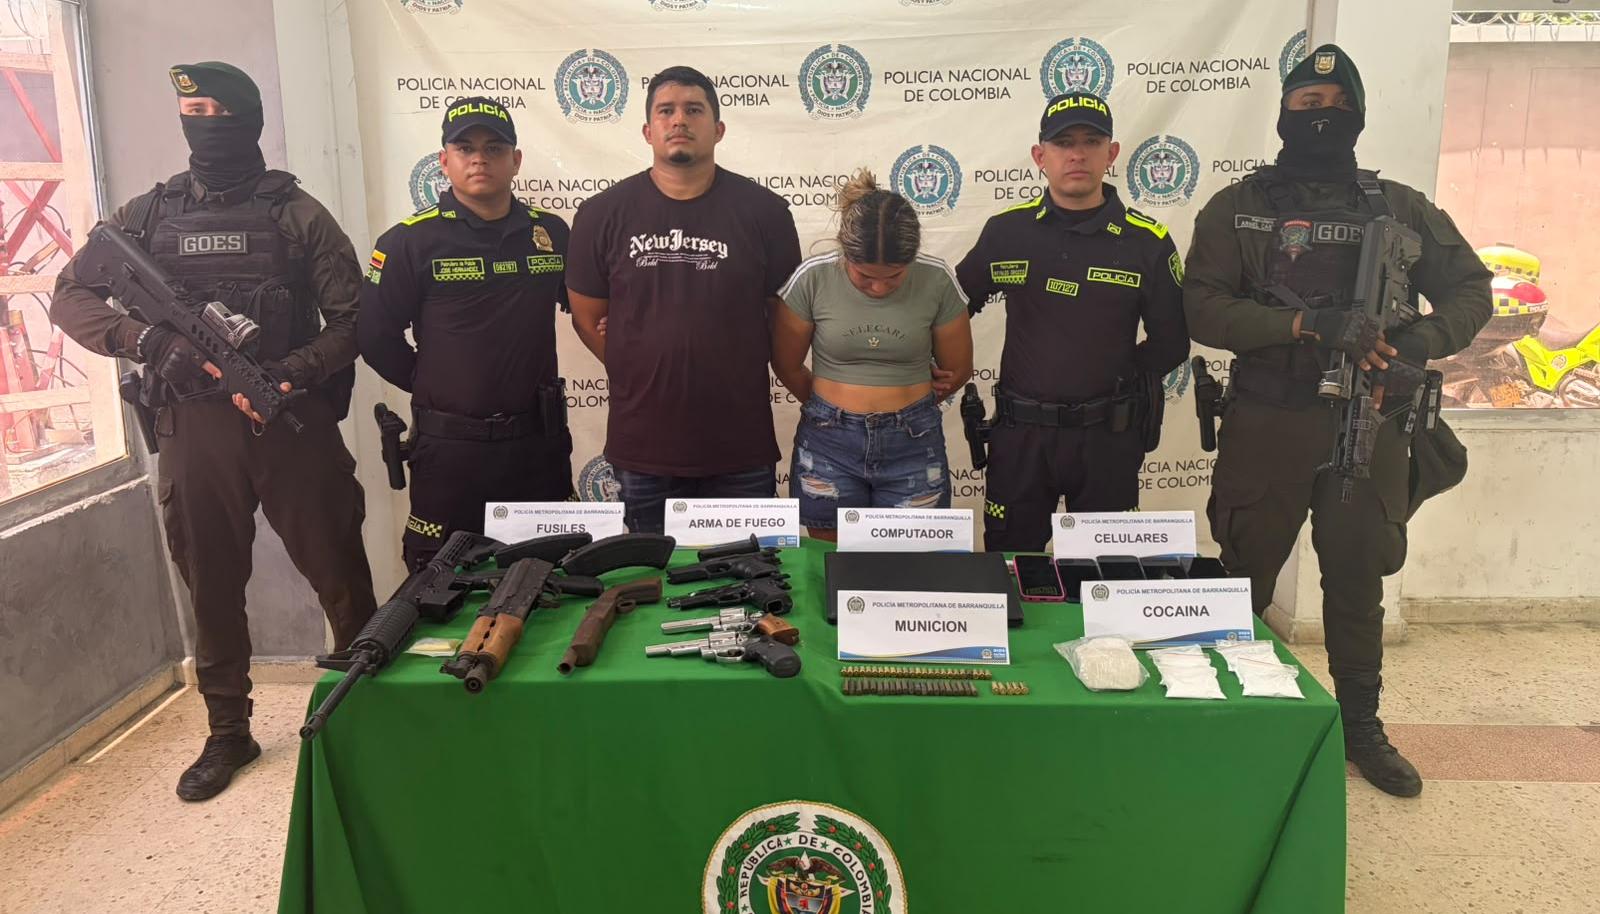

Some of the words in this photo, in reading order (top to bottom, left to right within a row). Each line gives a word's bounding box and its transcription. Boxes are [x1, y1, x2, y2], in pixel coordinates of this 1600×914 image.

[1127, 62, 1185, 76] POLICIA
[1189, 57, 1270, 74] NACIONAL
[884, 70, 943, 85] POLICIA
[949, 68, 1031, 83] NACIONAL
[397, 78, 456, 91] POLICIA
[460, 77, 545, 90] NACIONAL
[1146, 80, 1165, 93] DE
[1170, 77, 1251, 92] COLOMBIA
[720, 94, 770, 107] OMBIA
[904, 90, 924, 102] DE
[929, 87, 1011, 101] COLOMBIA
[420, 97, 440, 109] DE
[975, 169, 1033, 182] POLICIA
[995, 187, 1014, 200] DE
[1319, 225, 1361, 241] GOE
[183, 236, 241, 251] GOES
[1049, 281, 1075, 293] 107127
[1157, 475, 1209, 489] COLOM
[536, 523, 586, 534] FUSILES
[689, 519, 722, 528] ARMA
[726, 518, 741, 527] DE
[745, 518, 785, 527] FUEGO
[871, 528, 953, 539] COMPUTADOR
[1095, 533, 1168, 543] CELULARES
[1143, 605, 1209, 617] COCAINA
[895, 620, 967, 632] MUNICION
[799, 834, 818, 846] DE
